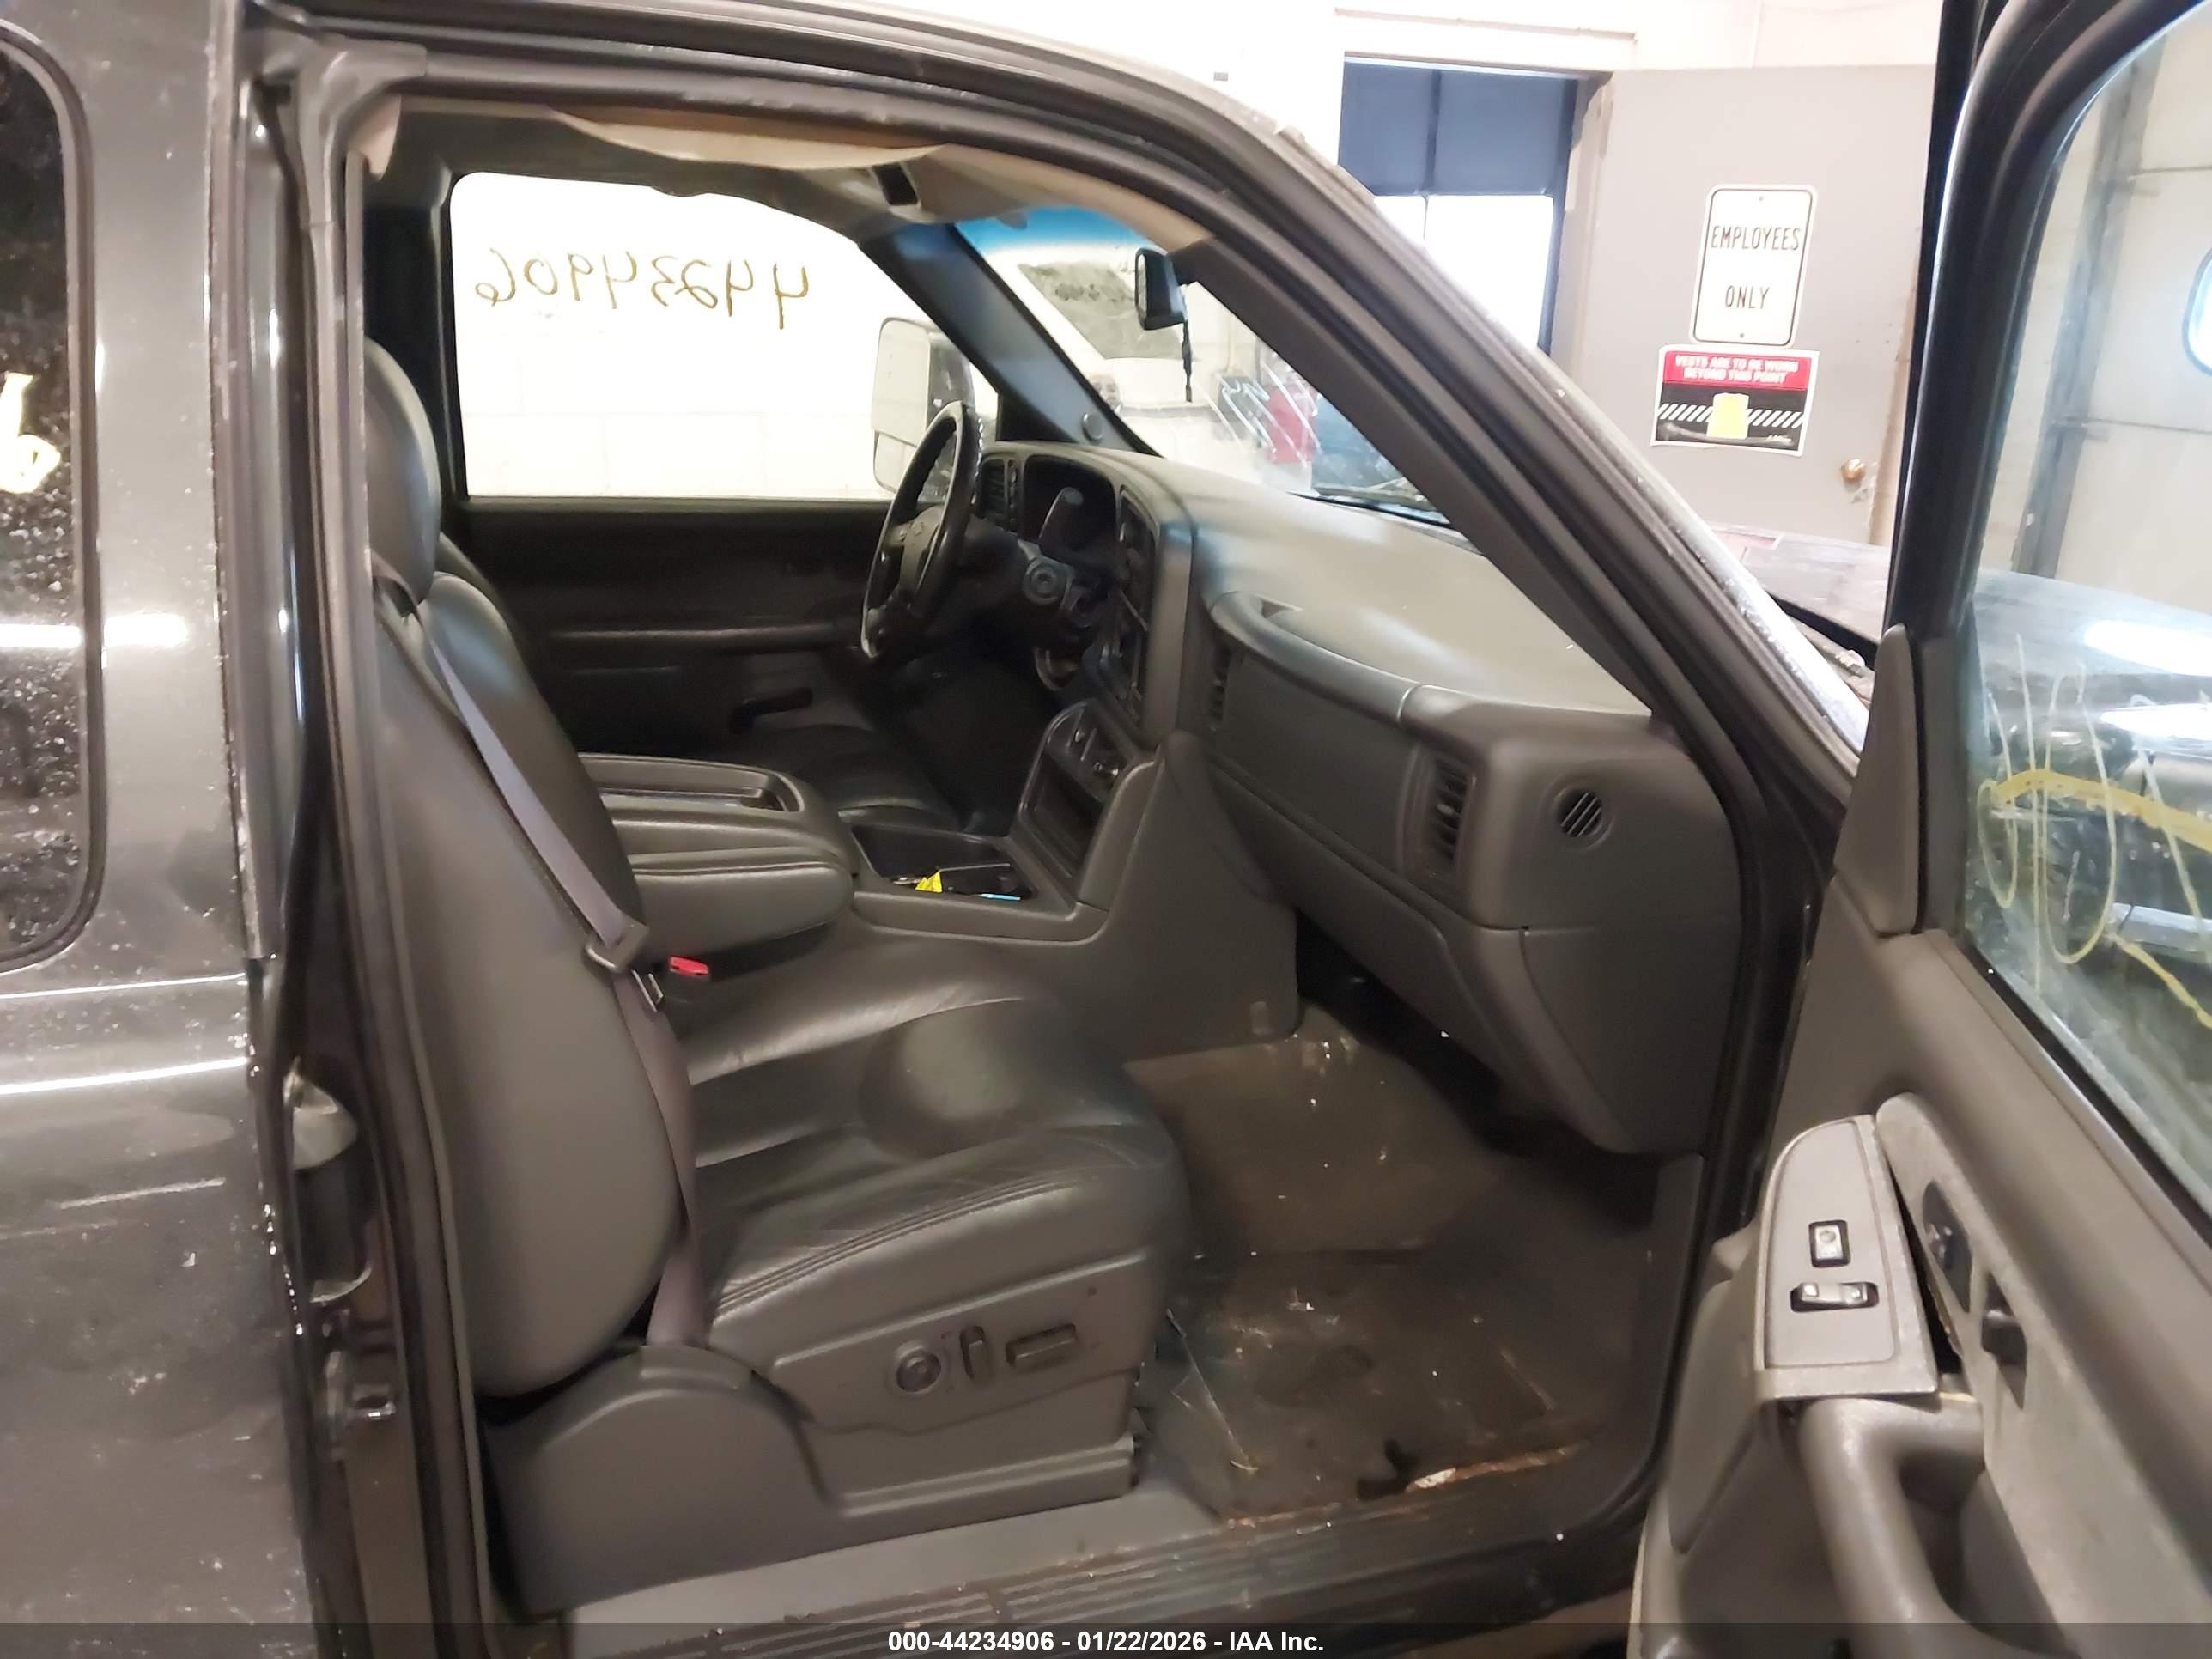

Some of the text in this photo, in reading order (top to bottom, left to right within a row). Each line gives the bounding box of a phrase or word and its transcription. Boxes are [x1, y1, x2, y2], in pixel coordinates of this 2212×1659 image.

[1711, 225, 1802, 251] EMPLOYEES
[1725, 285, 1770, 309] ONLY
[1733, 357, 1747, 370] TO
